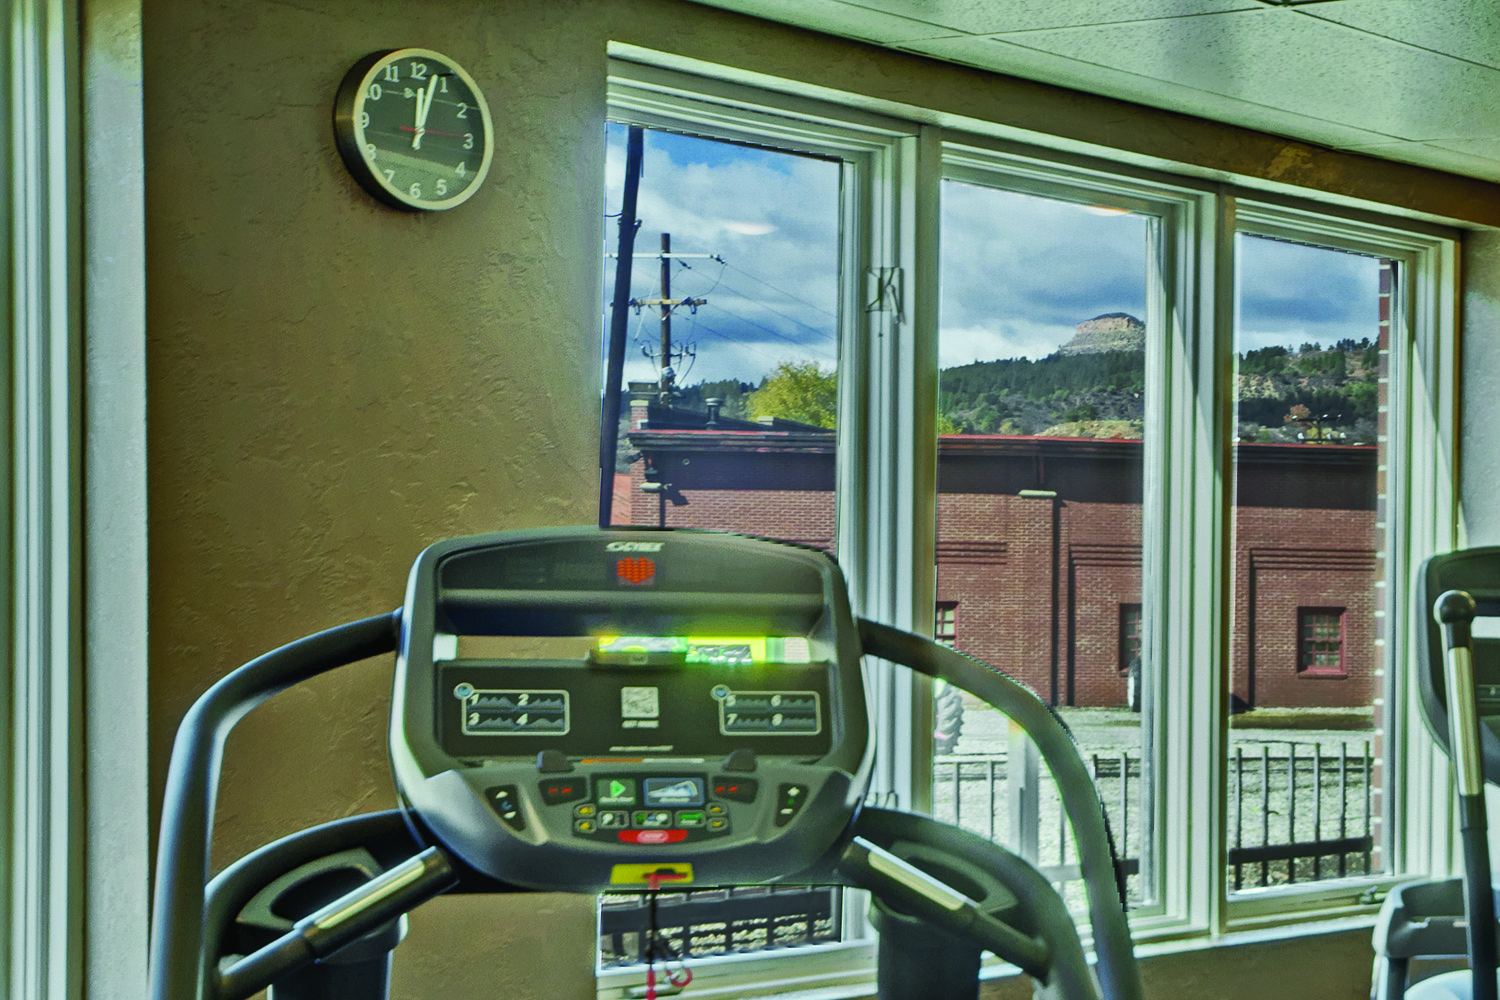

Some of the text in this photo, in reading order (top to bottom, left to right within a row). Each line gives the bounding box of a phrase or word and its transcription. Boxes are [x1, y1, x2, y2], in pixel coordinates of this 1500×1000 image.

[384, 65, 400, 83] 11
[410, 62, 427, 80] 12
[439, 77, 449, 93] 1
[456, 102, 468, 119] 2
[361, 112, 370, 129] 9
[462, 133, 474, 150] 3
[383, 169, 395, 184] 7
[455, 161, 466, 178] 4
[409, 182, 421, 199] 6
[436, 179, 447, 196] 5
[517, 693, 530, 706] 2
[467, 713, 480, 726] 3
[516, 712, 528, 725] 4
